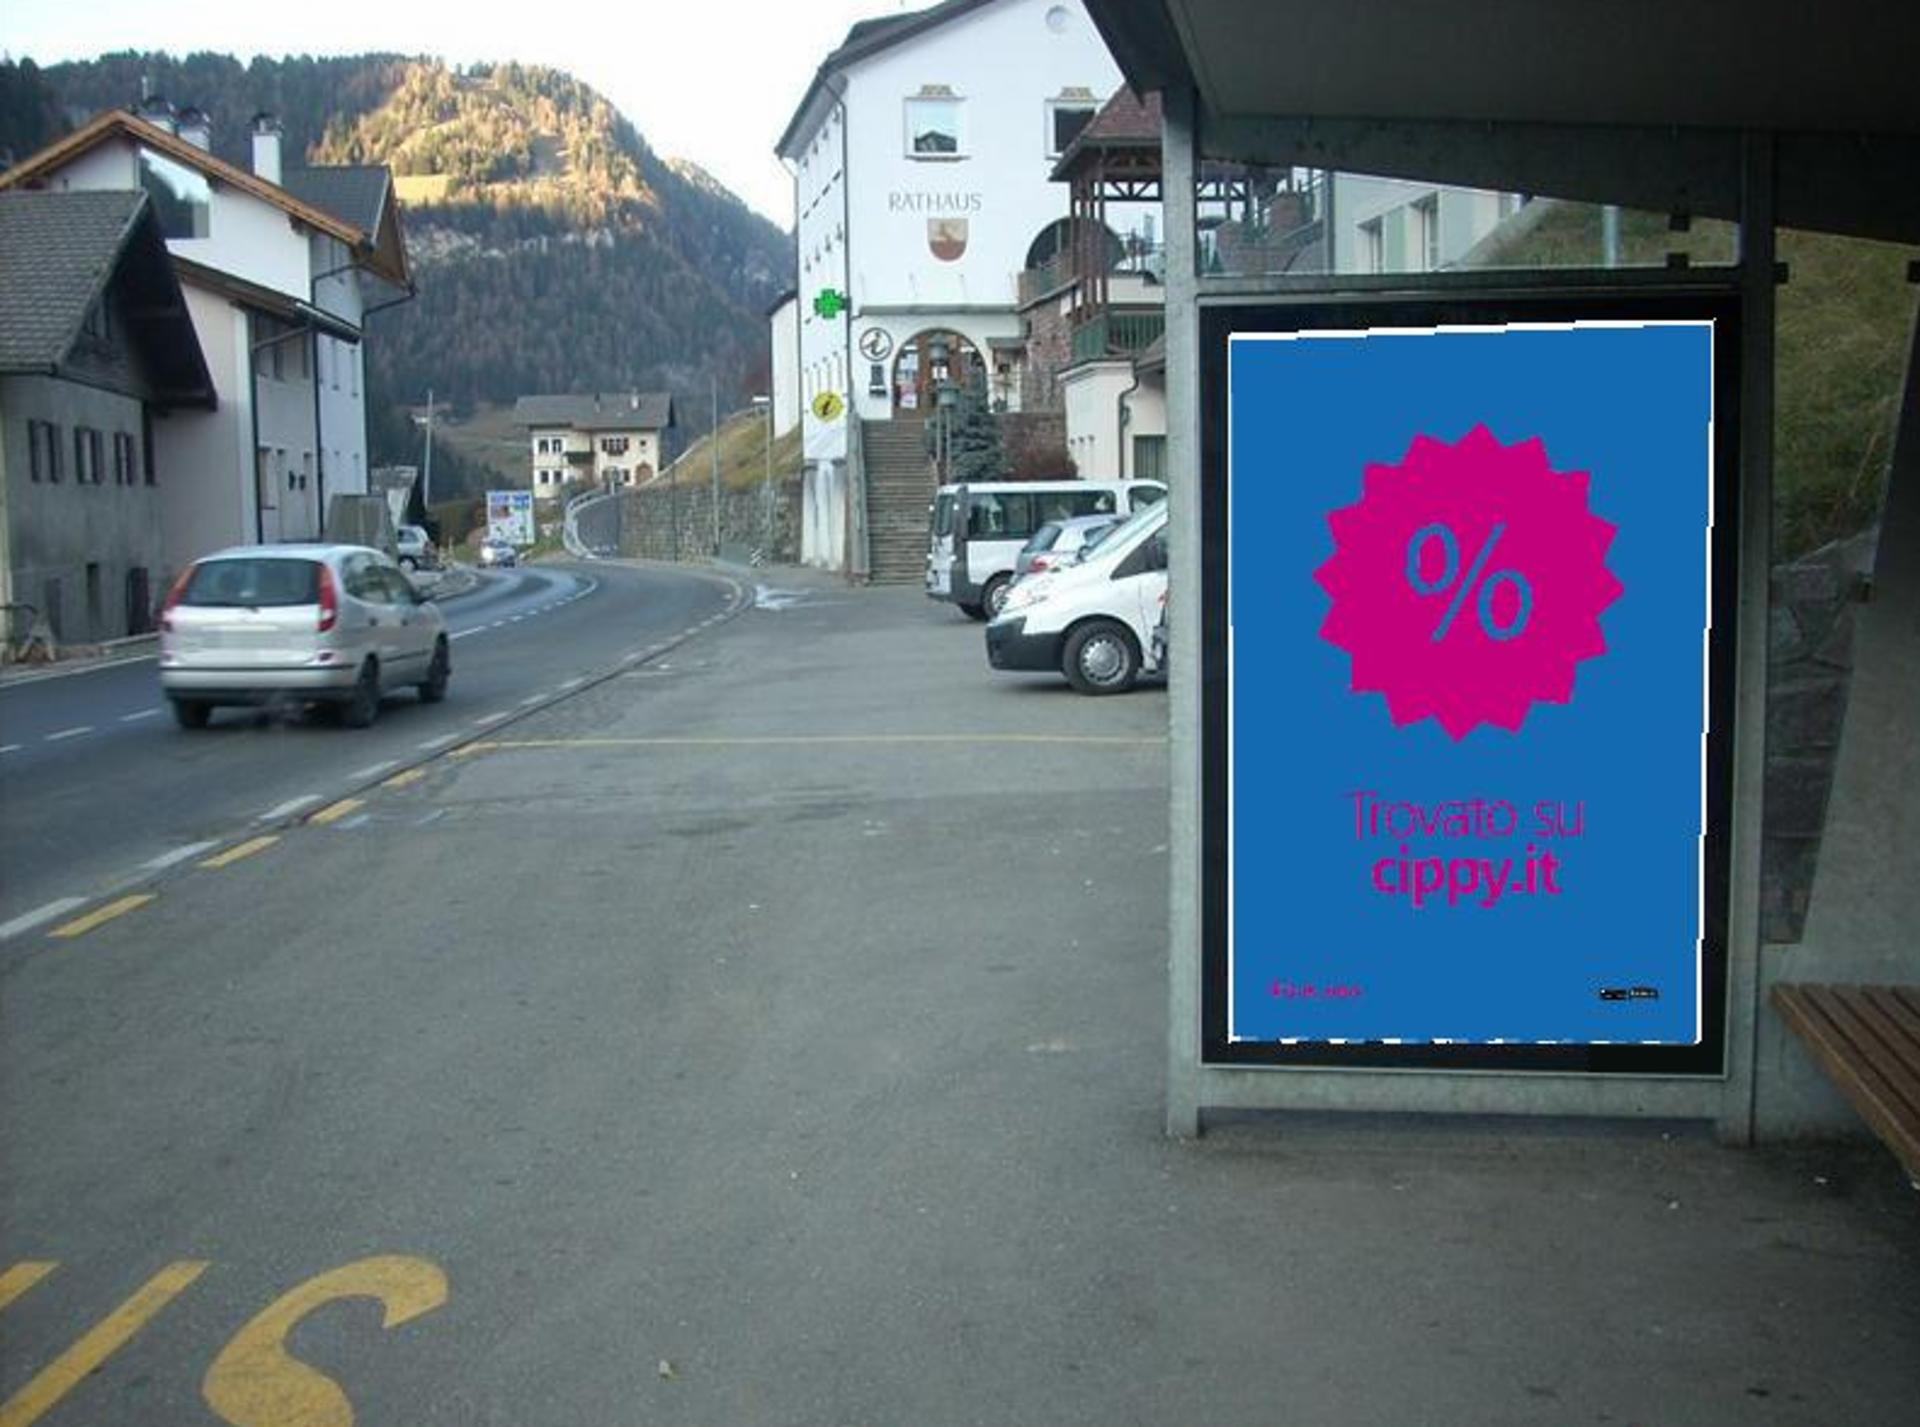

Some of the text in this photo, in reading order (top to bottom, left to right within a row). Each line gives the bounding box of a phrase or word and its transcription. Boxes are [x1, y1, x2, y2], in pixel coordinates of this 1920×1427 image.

[888, 192, 983, 212] RATHAUS
[1350, 790, 1585, 840] Trovato su
[1371, 843, 1563, 908] cippy.it
